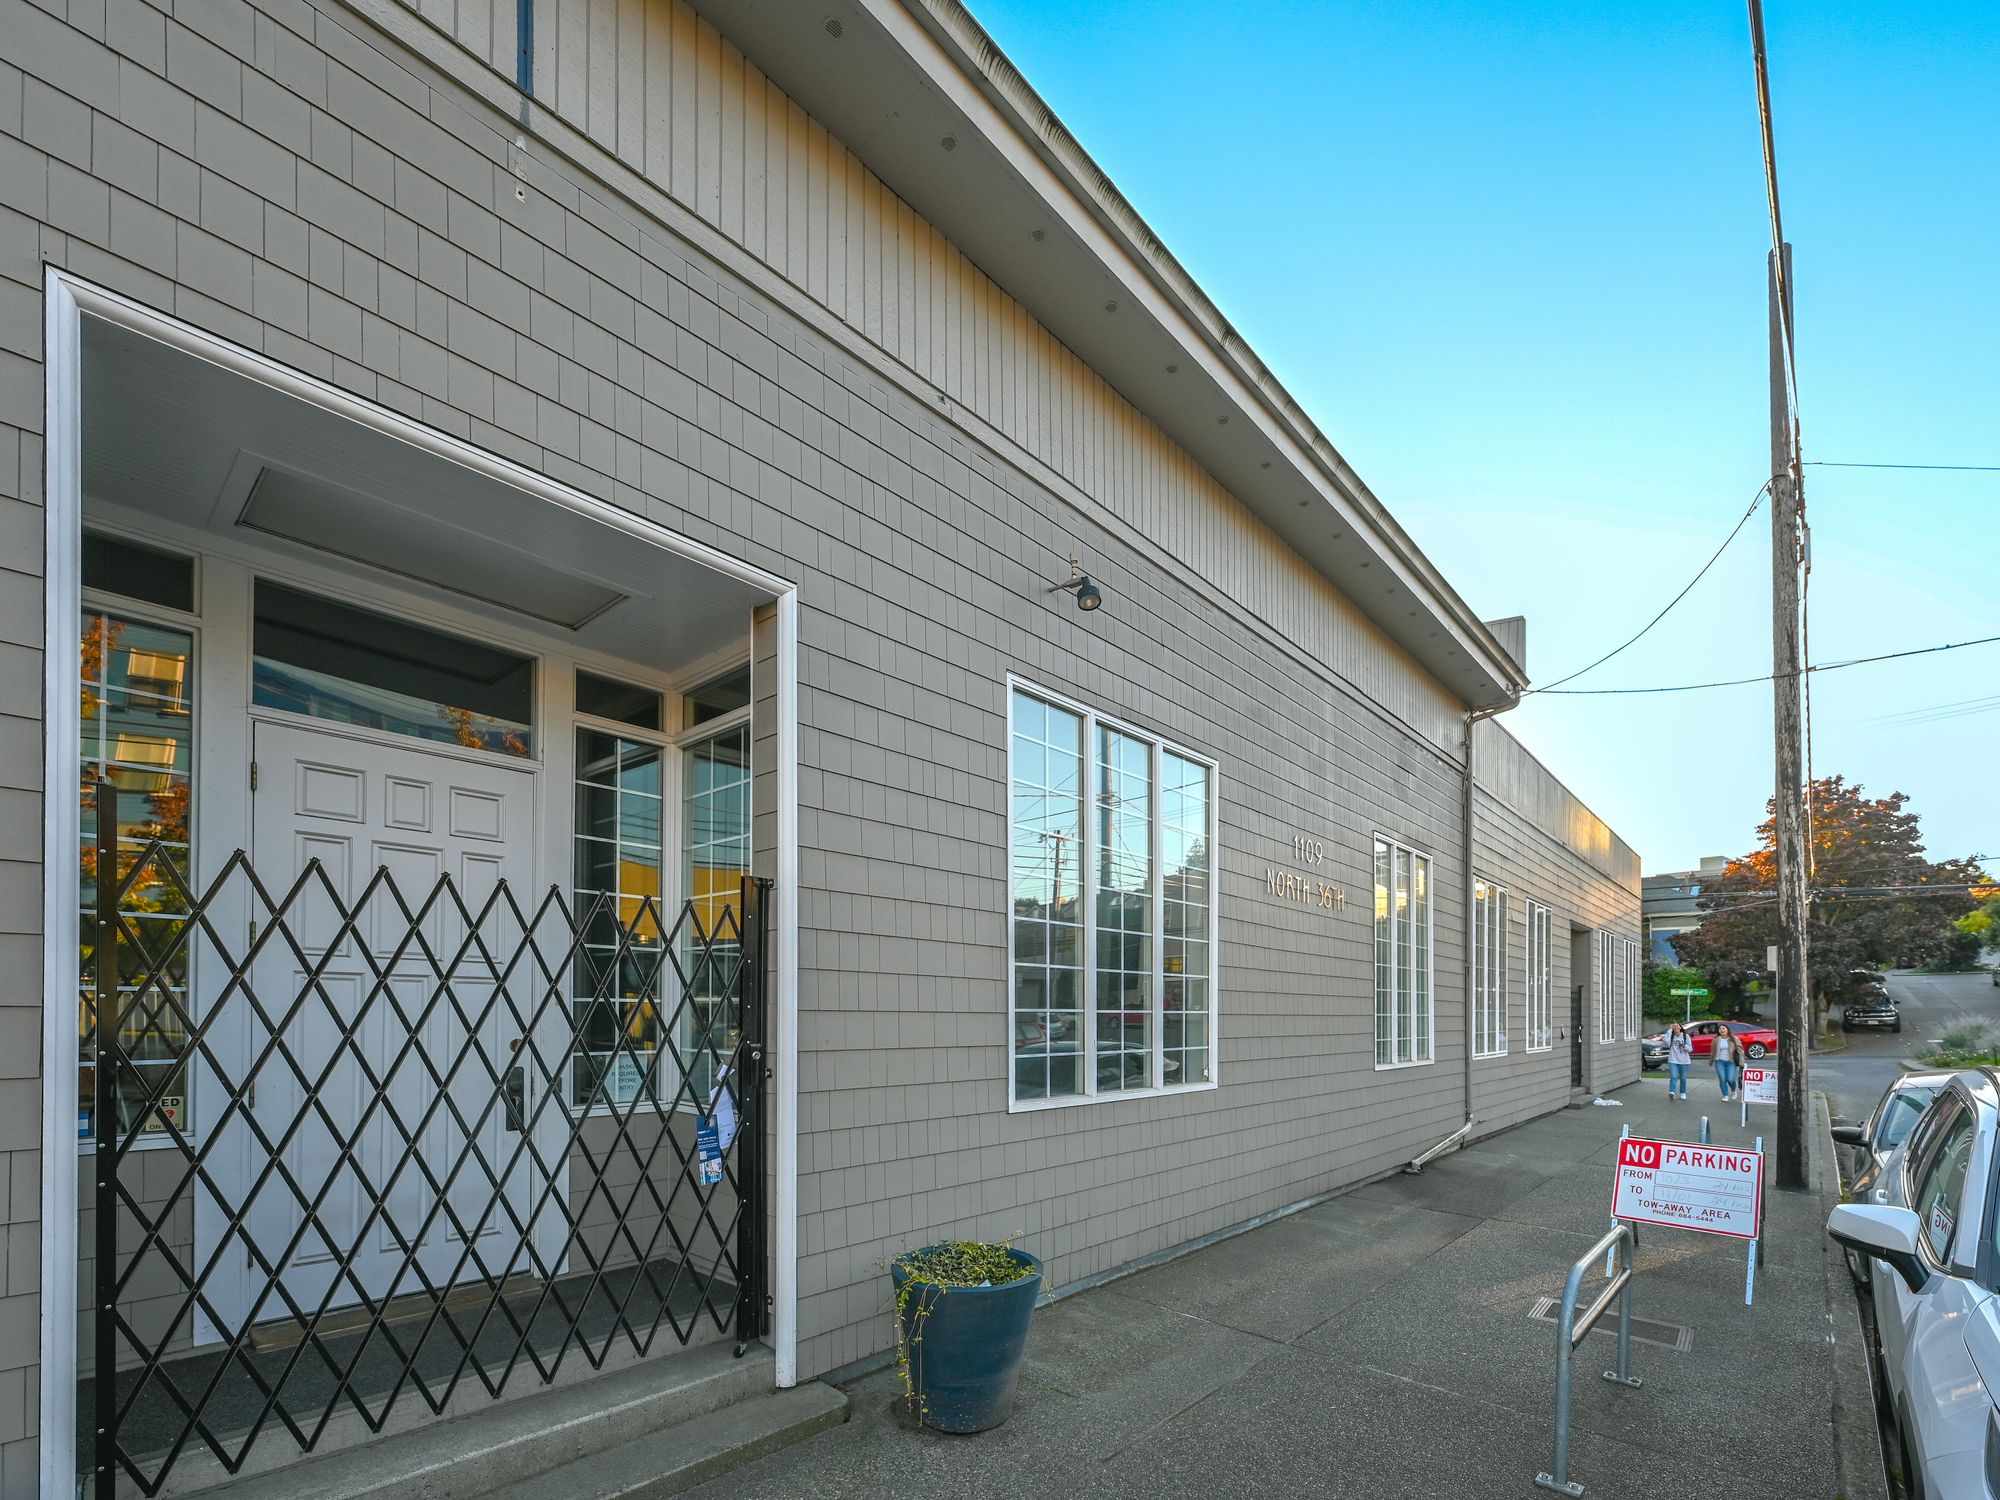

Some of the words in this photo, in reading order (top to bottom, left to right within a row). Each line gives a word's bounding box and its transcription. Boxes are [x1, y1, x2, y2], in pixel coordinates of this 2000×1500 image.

[1293, 835, 1323, 866] 1109
[1266, 867, 1310, 904] NORTH
[1317, 882, 1345, 912] 36TH
[1746, 1071, 1761, 1080] NO
[1625, 1143, 1655, 1165] NO
[1665, 1149, 1752, 1173] PARKING
[1623, 1169, 1653, 1180] FROM
[1630, 1185, 1643, 1195] TO
[1638, 1199, 1693, 1214] TOW-AWAY
[1701, 1208, 1731, 1220] AREA
